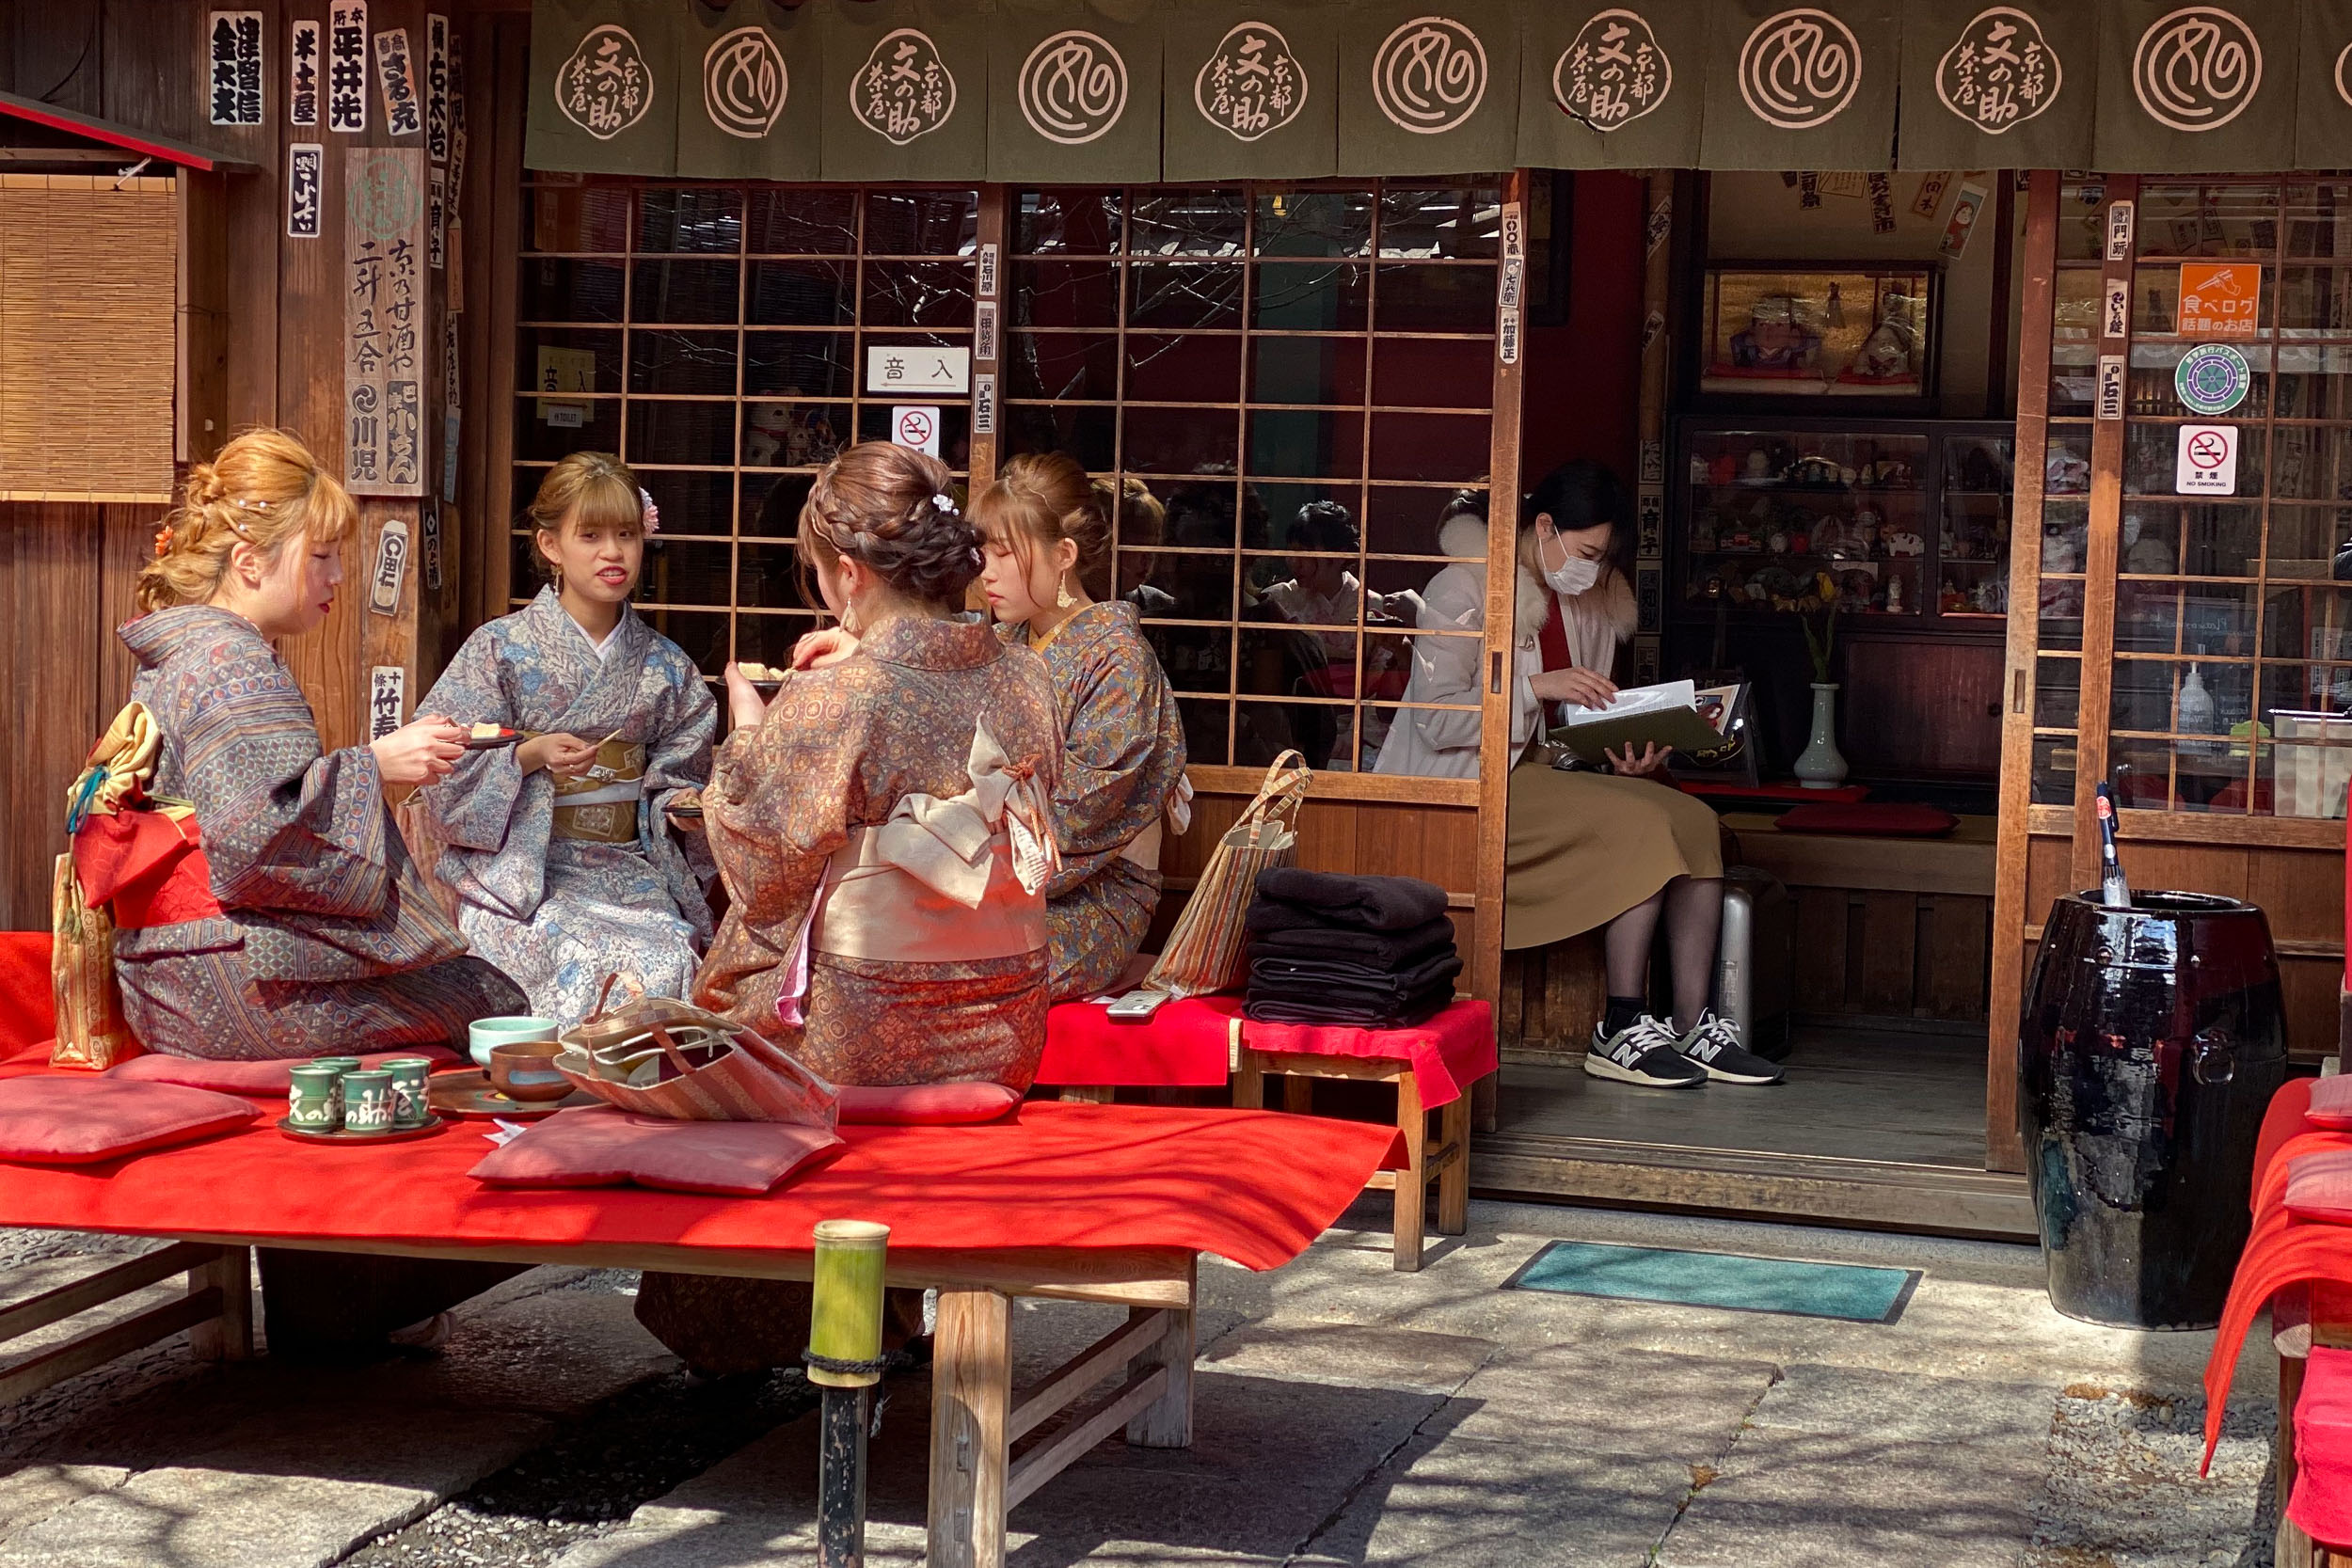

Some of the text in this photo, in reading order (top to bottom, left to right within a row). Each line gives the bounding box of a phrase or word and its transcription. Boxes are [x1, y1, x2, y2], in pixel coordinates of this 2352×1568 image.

[331, 26, 363, 128] 平井光
[568, 55, 593, 114] 茶屋
[587, 37, 623, 130] 文の助
[621, 56, 641, 117] 京都
[864, 61, 890, 120] 茶屋
[887, 40, 921, 135] 文の助
[919, 60, 943, 121] 京都
[1210, 58, 1234, 117] 茶屋
[1231, 34, 1270, 133] 文の助
[1268, 54, 1293, 118] 京都
[1568, 41, 1594, 103] 茶屋
[1589, 22, 1632, 121] 文の助
[1629, 42, 1657, 106] 京都
[1953, 42, 1981, 106] 茶屋
[1978, 21, 2020, 124] 文の助
[2018, 41, 2044, 107] 京都
[2182, 318, 2253, 332] 話題のお店
[2184, 294, 2256, 315] 食べログ
[2195, 471, 2218, 480] 禁煙
[1612, 1043, 1642, 1069] N
[1690, 1038, 1722, 1063] N
